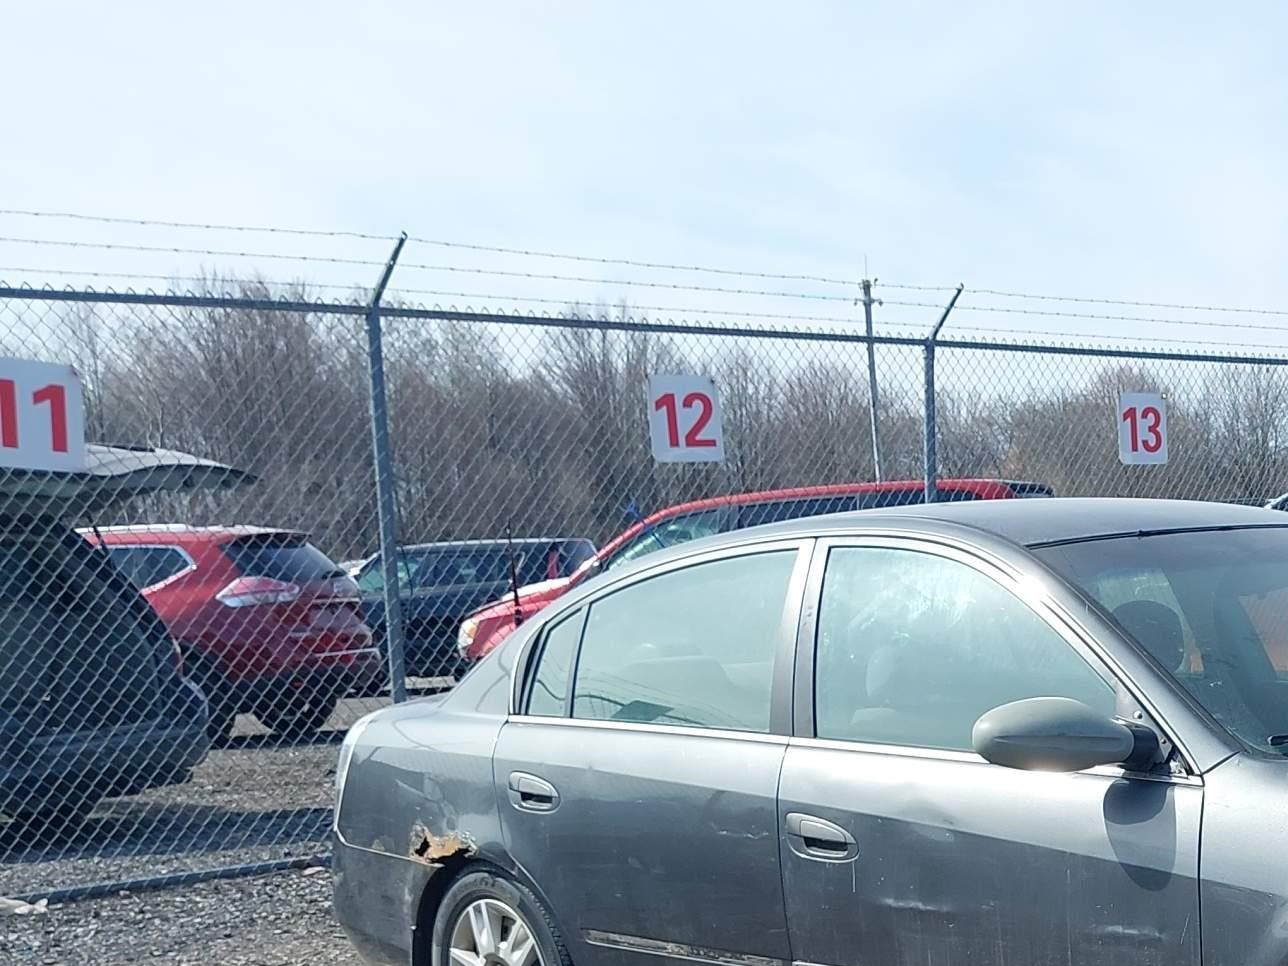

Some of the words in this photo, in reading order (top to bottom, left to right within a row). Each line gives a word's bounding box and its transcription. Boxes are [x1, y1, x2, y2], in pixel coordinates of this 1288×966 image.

[0, 379, 68, 453] 11
[655, 392, 717, 448] 12
[1122, 406, 1162, 453] 13
